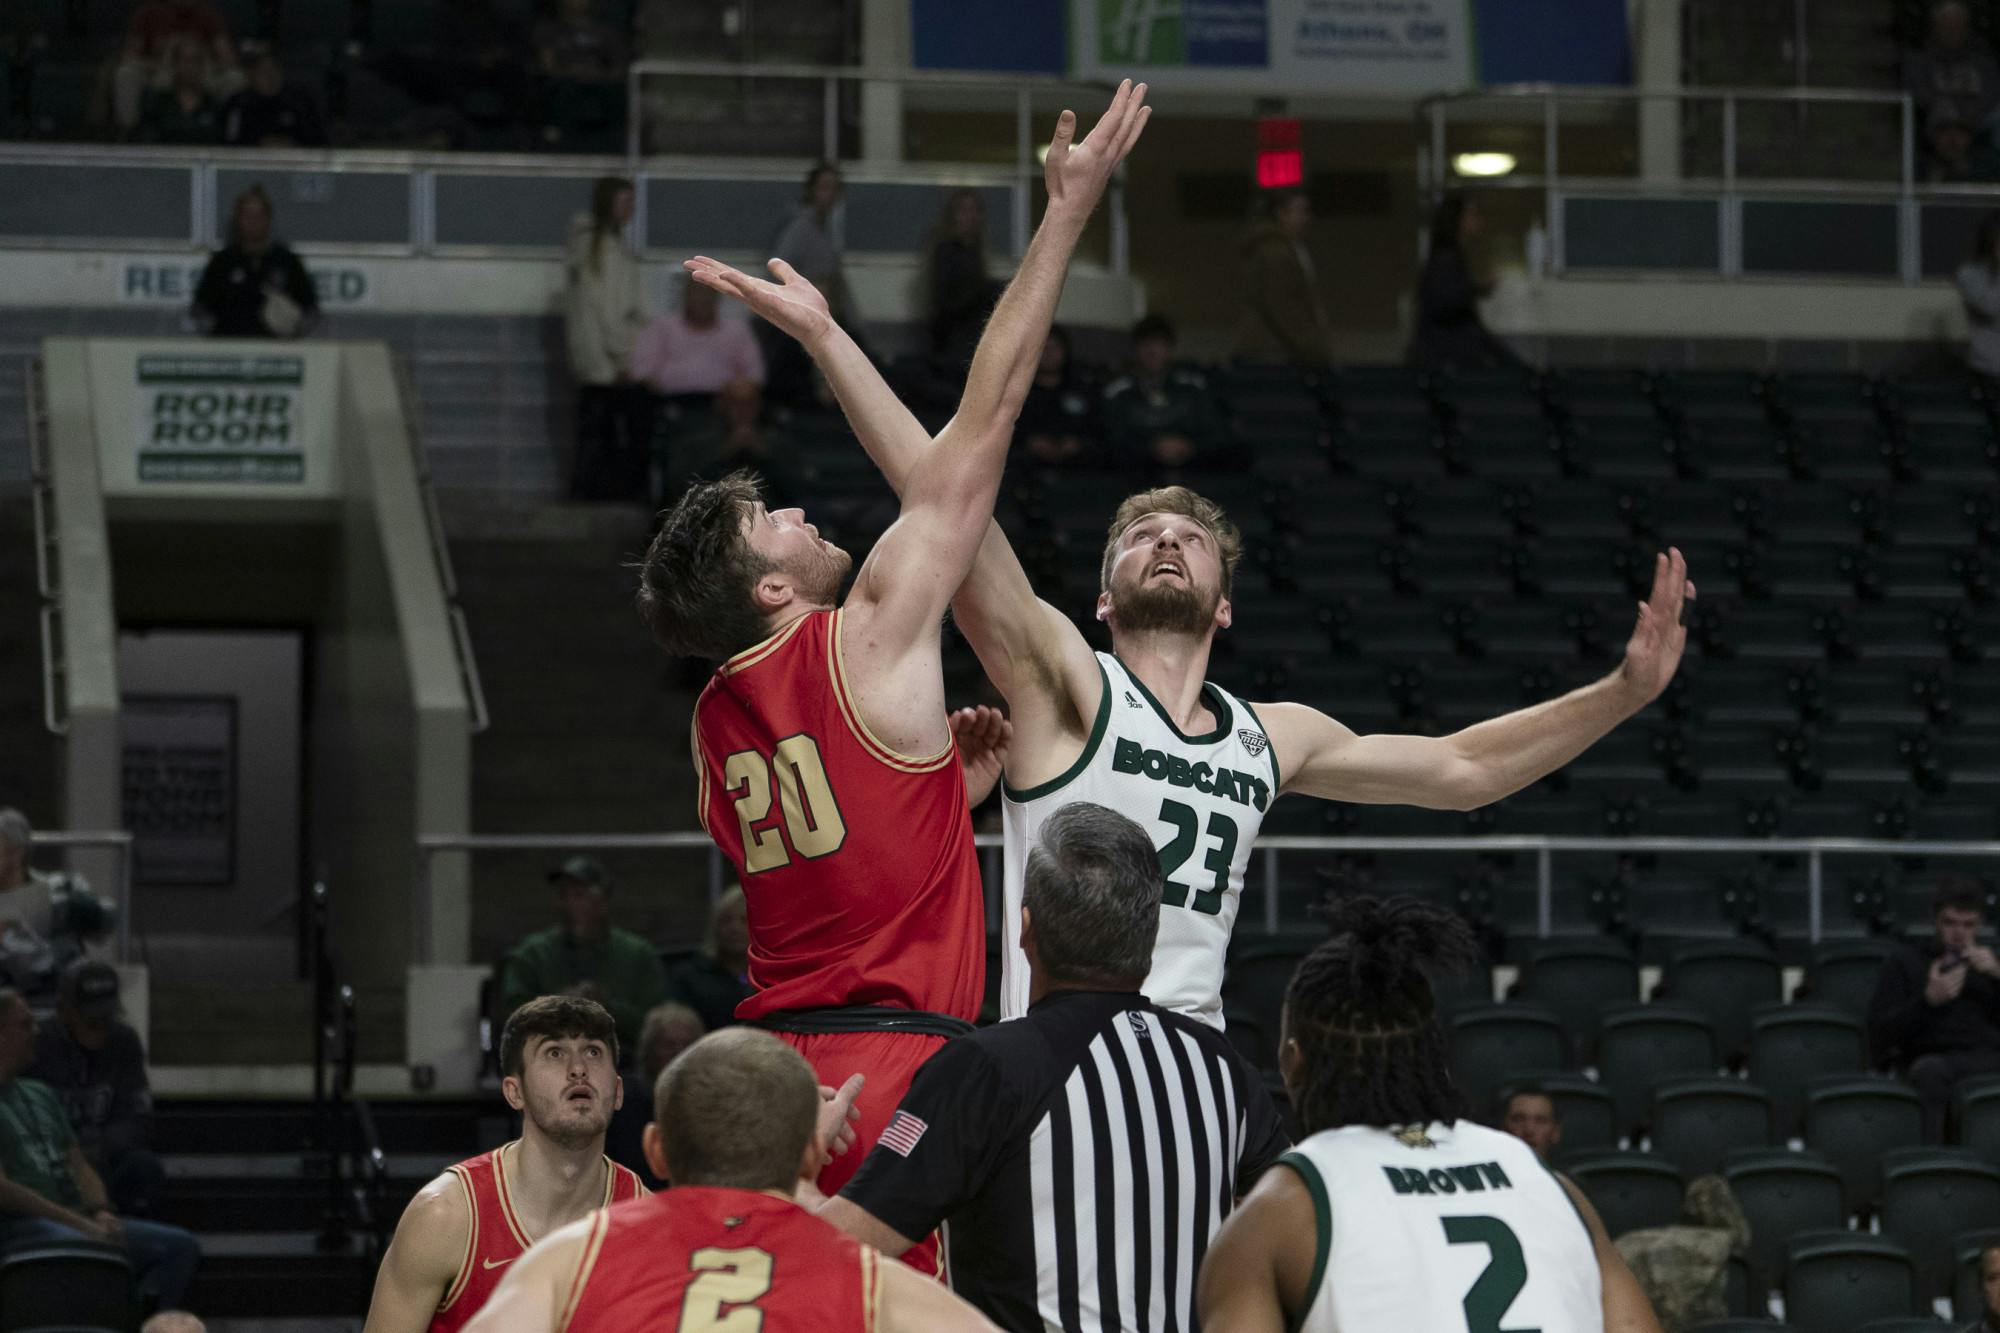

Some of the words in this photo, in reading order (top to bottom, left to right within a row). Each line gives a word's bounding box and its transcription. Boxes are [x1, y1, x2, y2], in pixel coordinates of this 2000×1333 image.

[152, 421, 292, 444] ROOM
[153, 394, 292, 418] ROHR
[724, 732, 848, 875] 20
[1112, 736, 1271, 813] BOBCATS
[1157, 797, 1239, 916] 23
[1381, 1161, 1513, 1195] BROWN
[676, 1246, 775, 1333] 2
[1440, 1215, 1542, 1333] 2
